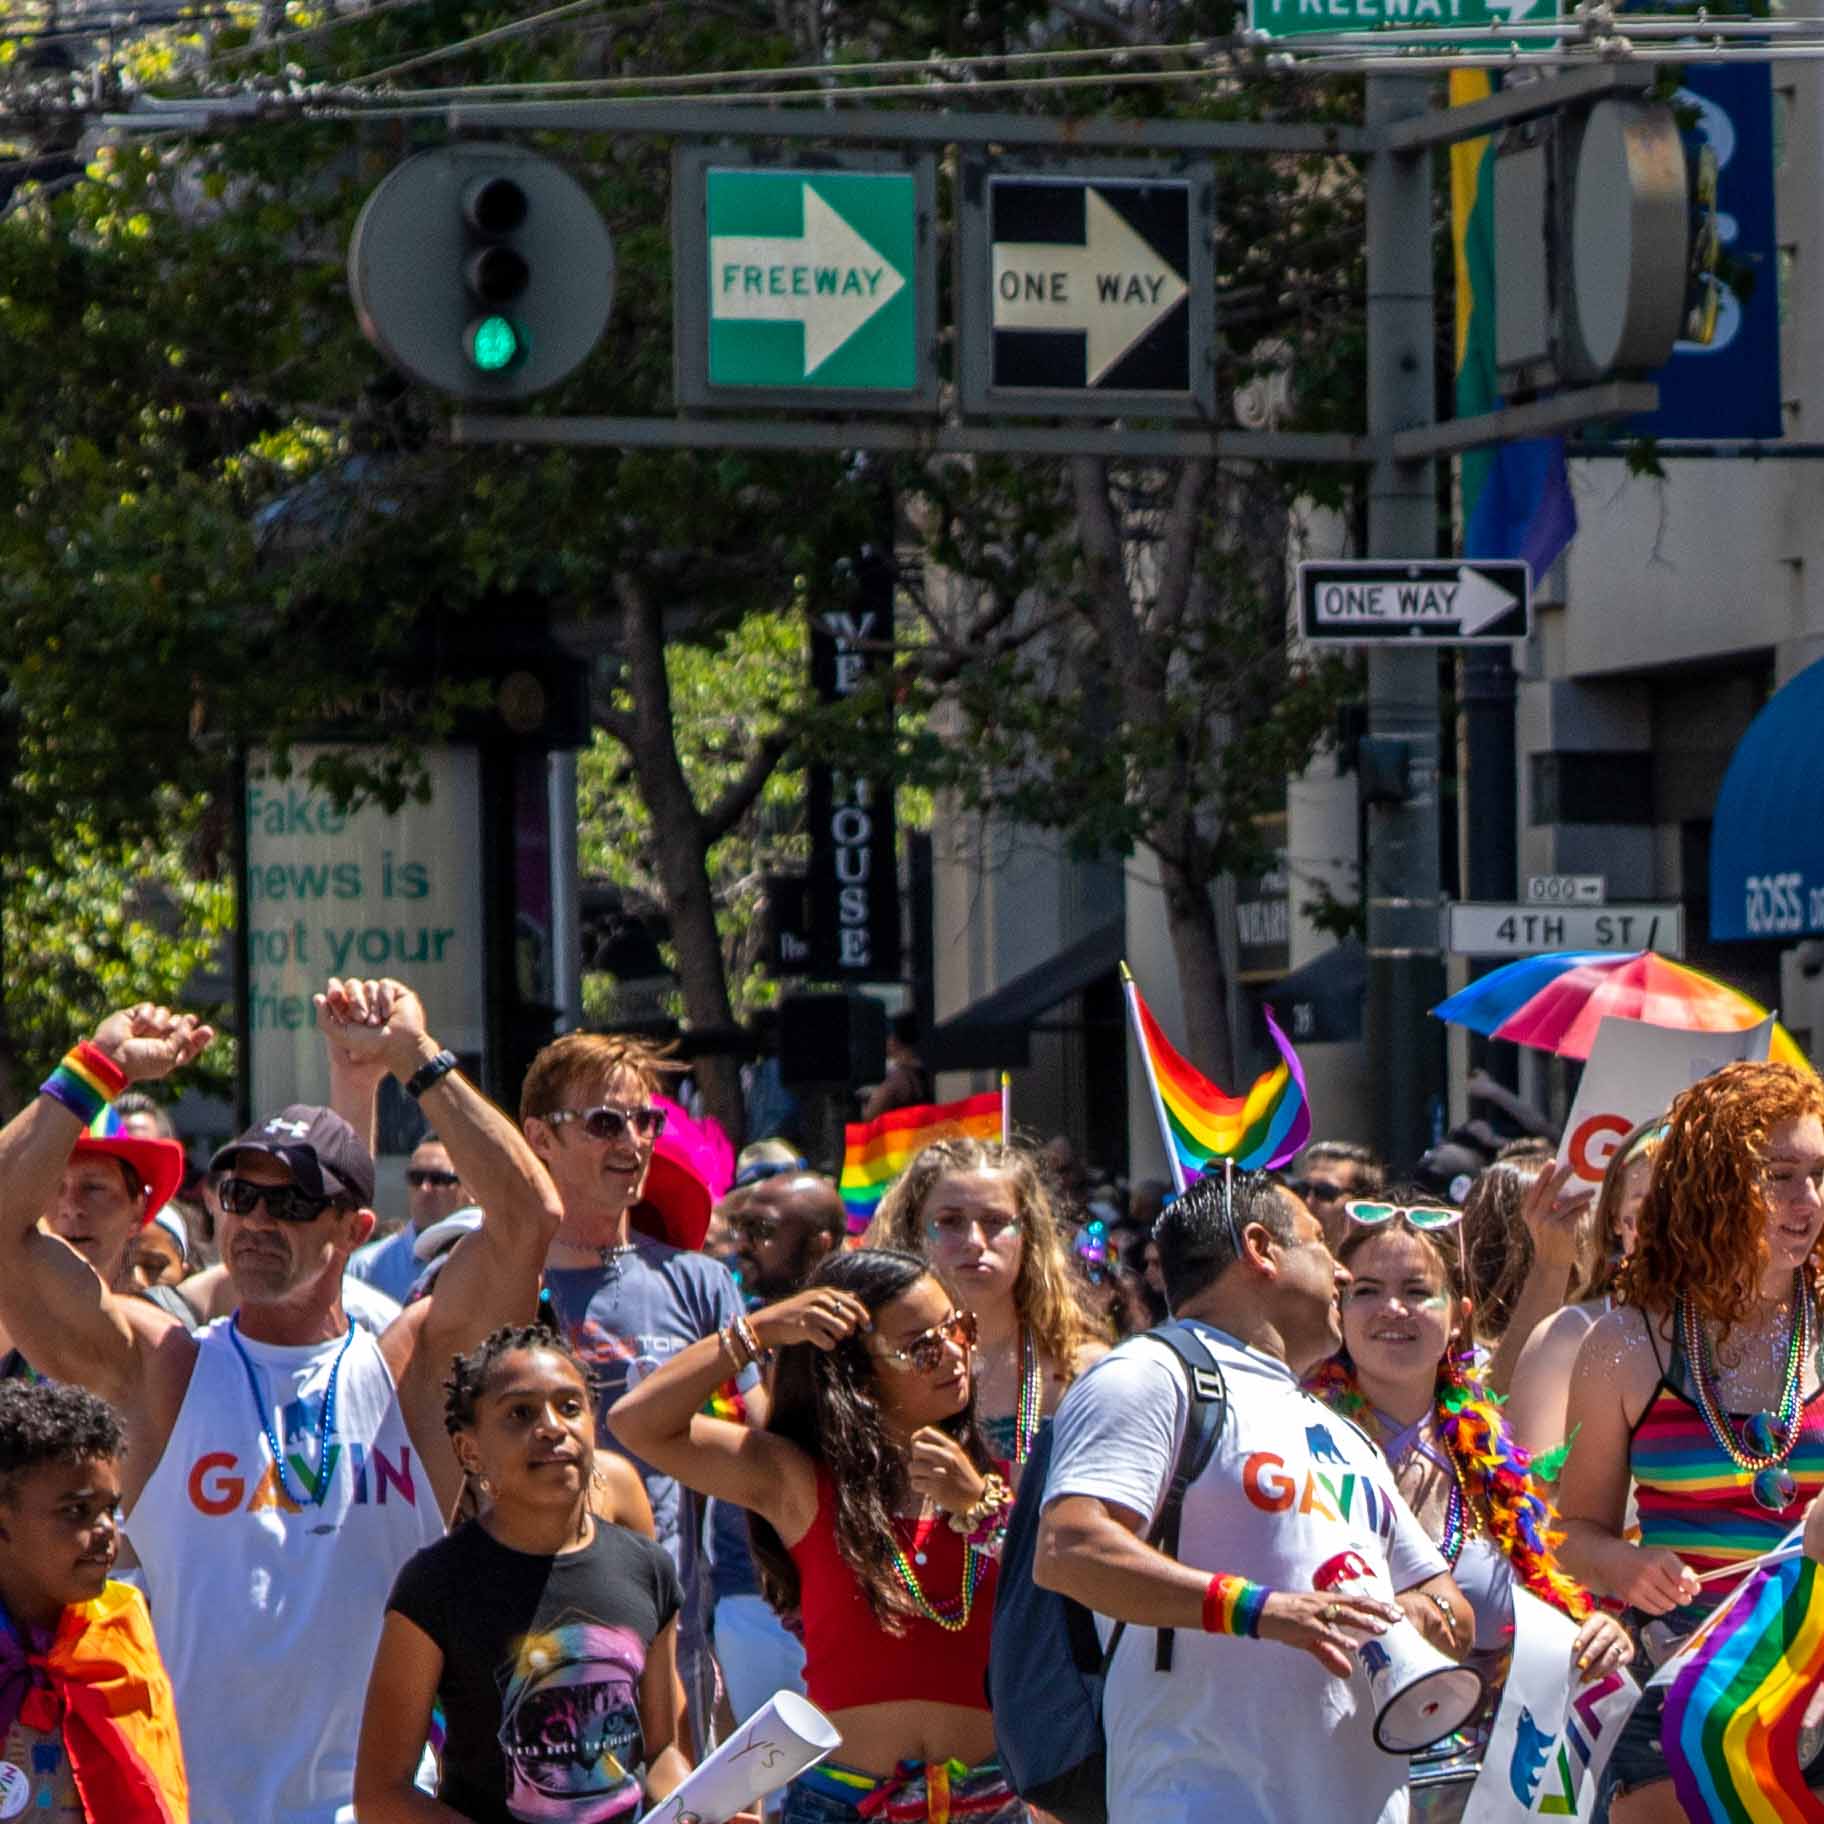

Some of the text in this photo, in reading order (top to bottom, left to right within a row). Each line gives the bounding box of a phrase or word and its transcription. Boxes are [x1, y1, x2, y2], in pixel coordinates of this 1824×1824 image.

[722, 263, 884, 296] FREEWAY
[1000, 271, 1166, 305] ONE WAY
[1324, 583, 1460, 618] ONE WAY
[381, 849, 430, 900] is
[1745, 872, 1803, 933] ROSS
[1495, 912, 1636, 945] 4TH ST
[321, 925, 456, 975] your
[188, 1444, 416, 1517] GAVIN
